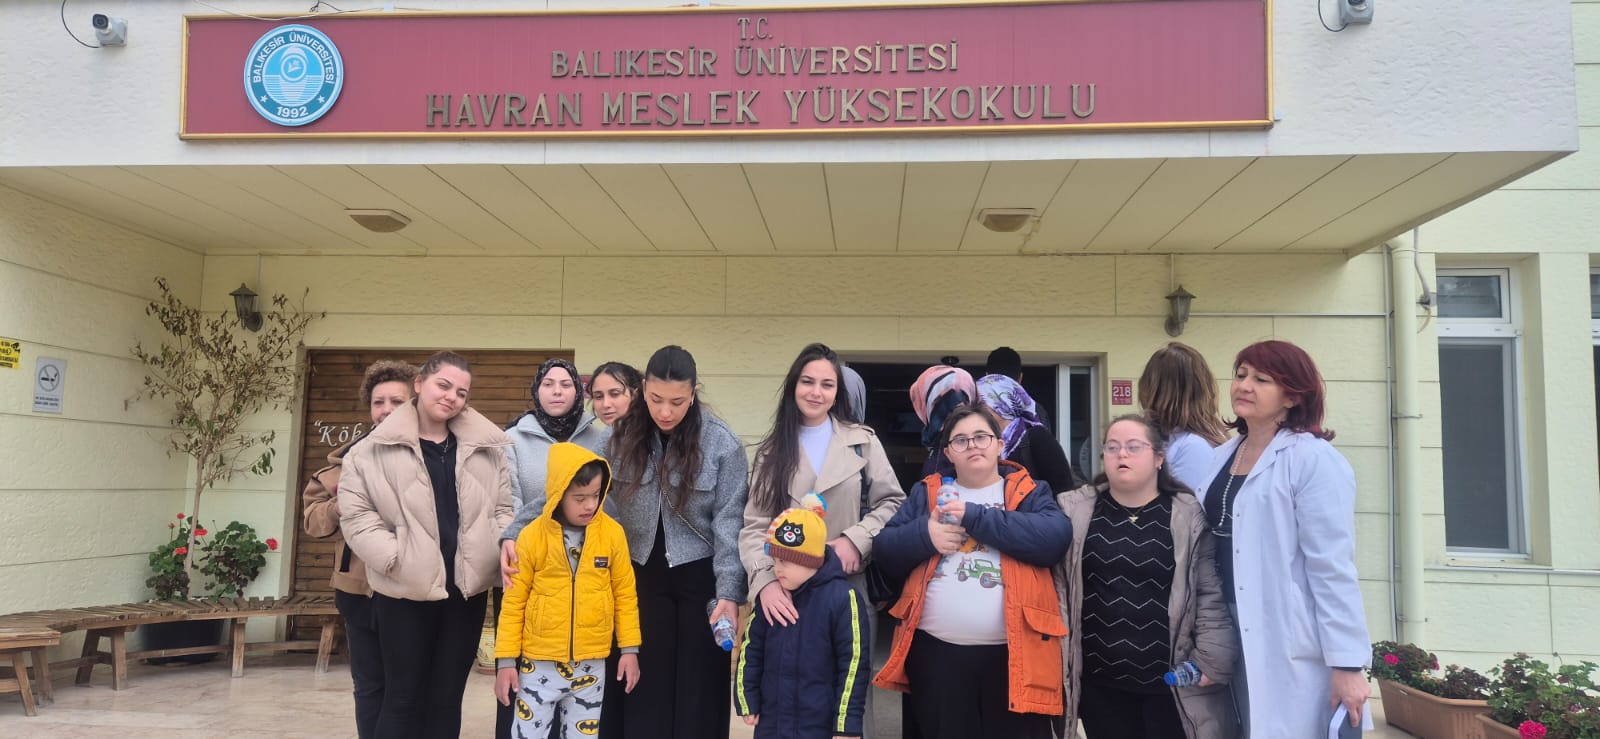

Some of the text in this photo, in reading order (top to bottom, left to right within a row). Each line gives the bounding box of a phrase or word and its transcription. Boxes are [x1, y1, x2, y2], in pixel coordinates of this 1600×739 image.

[737, 17, 773, 41] T.C.
[253, 31, 336, 85] BALIKESİR ÜNİVERSİTESİ
[551, 39, 959, 77] BALIKESİR ÜNİVERSİTESİ
[277, 106, 309, 118] 1992
[426, 83, 1097, 127] HAVRAN MESLEK YÜKSEKOKULU
[1113, 386, 1131, 397] 218
